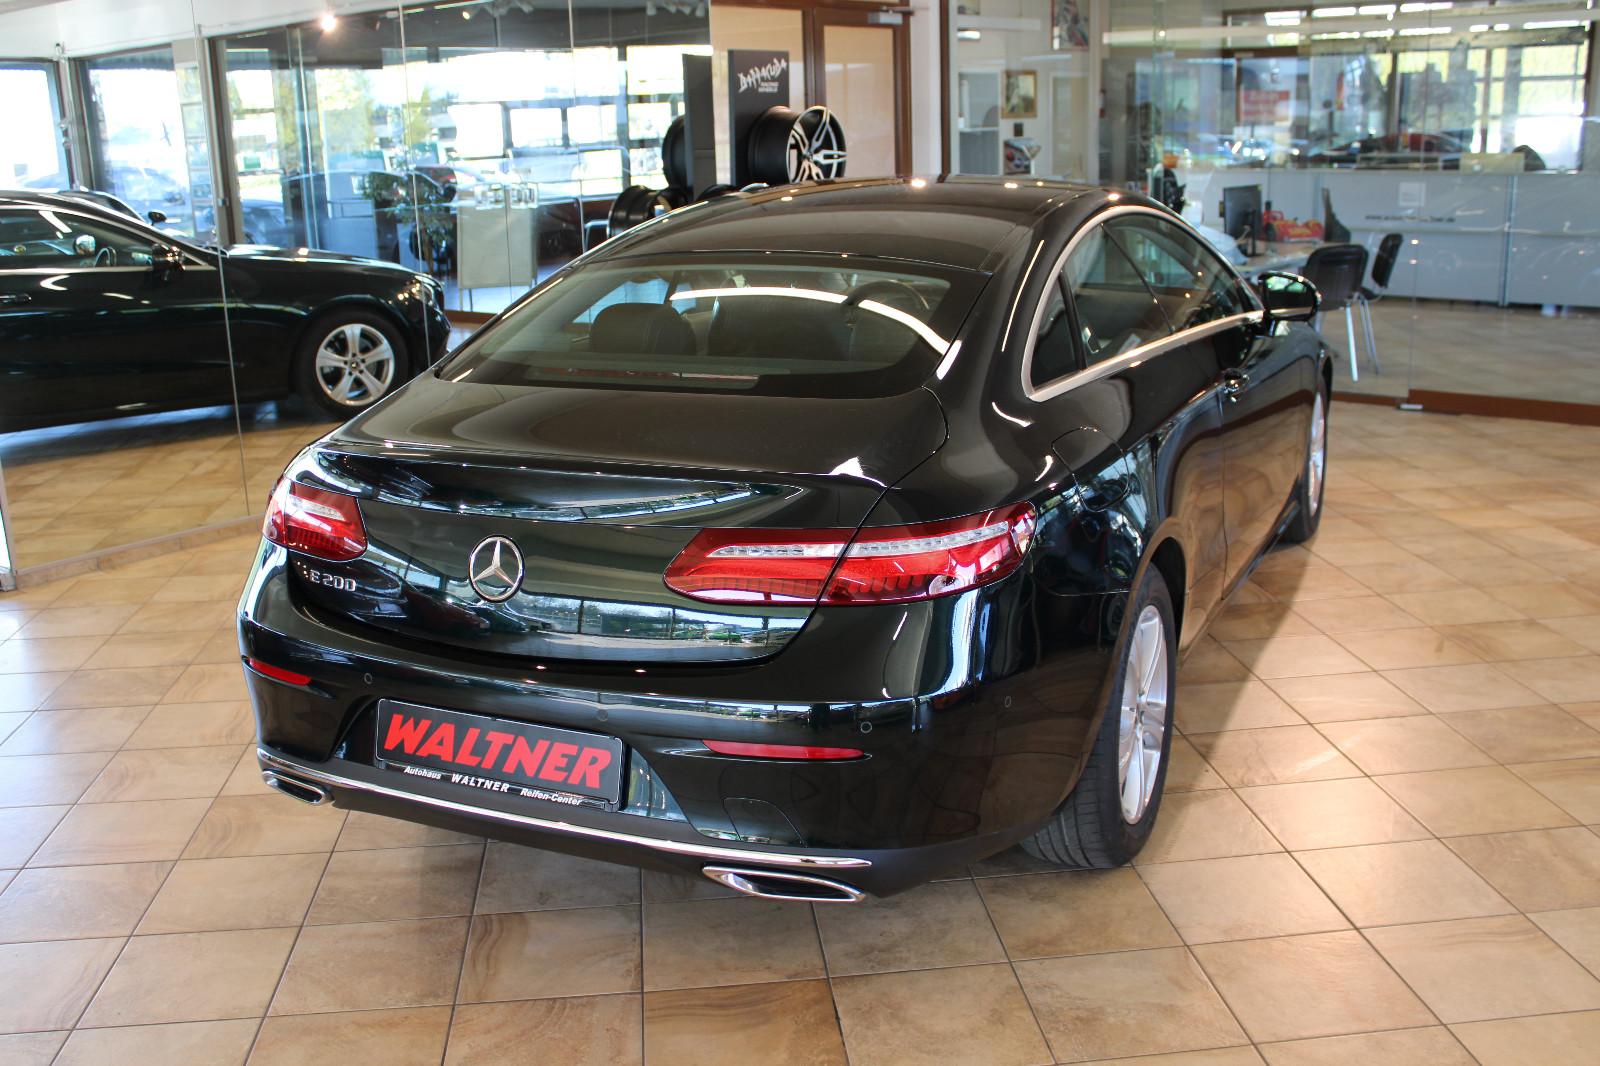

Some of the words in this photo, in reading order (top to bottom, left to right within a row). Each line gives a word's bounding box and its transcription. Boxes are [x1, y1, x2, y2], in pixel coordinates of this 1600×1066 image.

[384, 713, 612, 789] WALTNER
[404, 765, 442, 780] Autohaus
[451, 773, 510, 793] WALTNER
[520, 787, 583, 806] Reifen-Center
